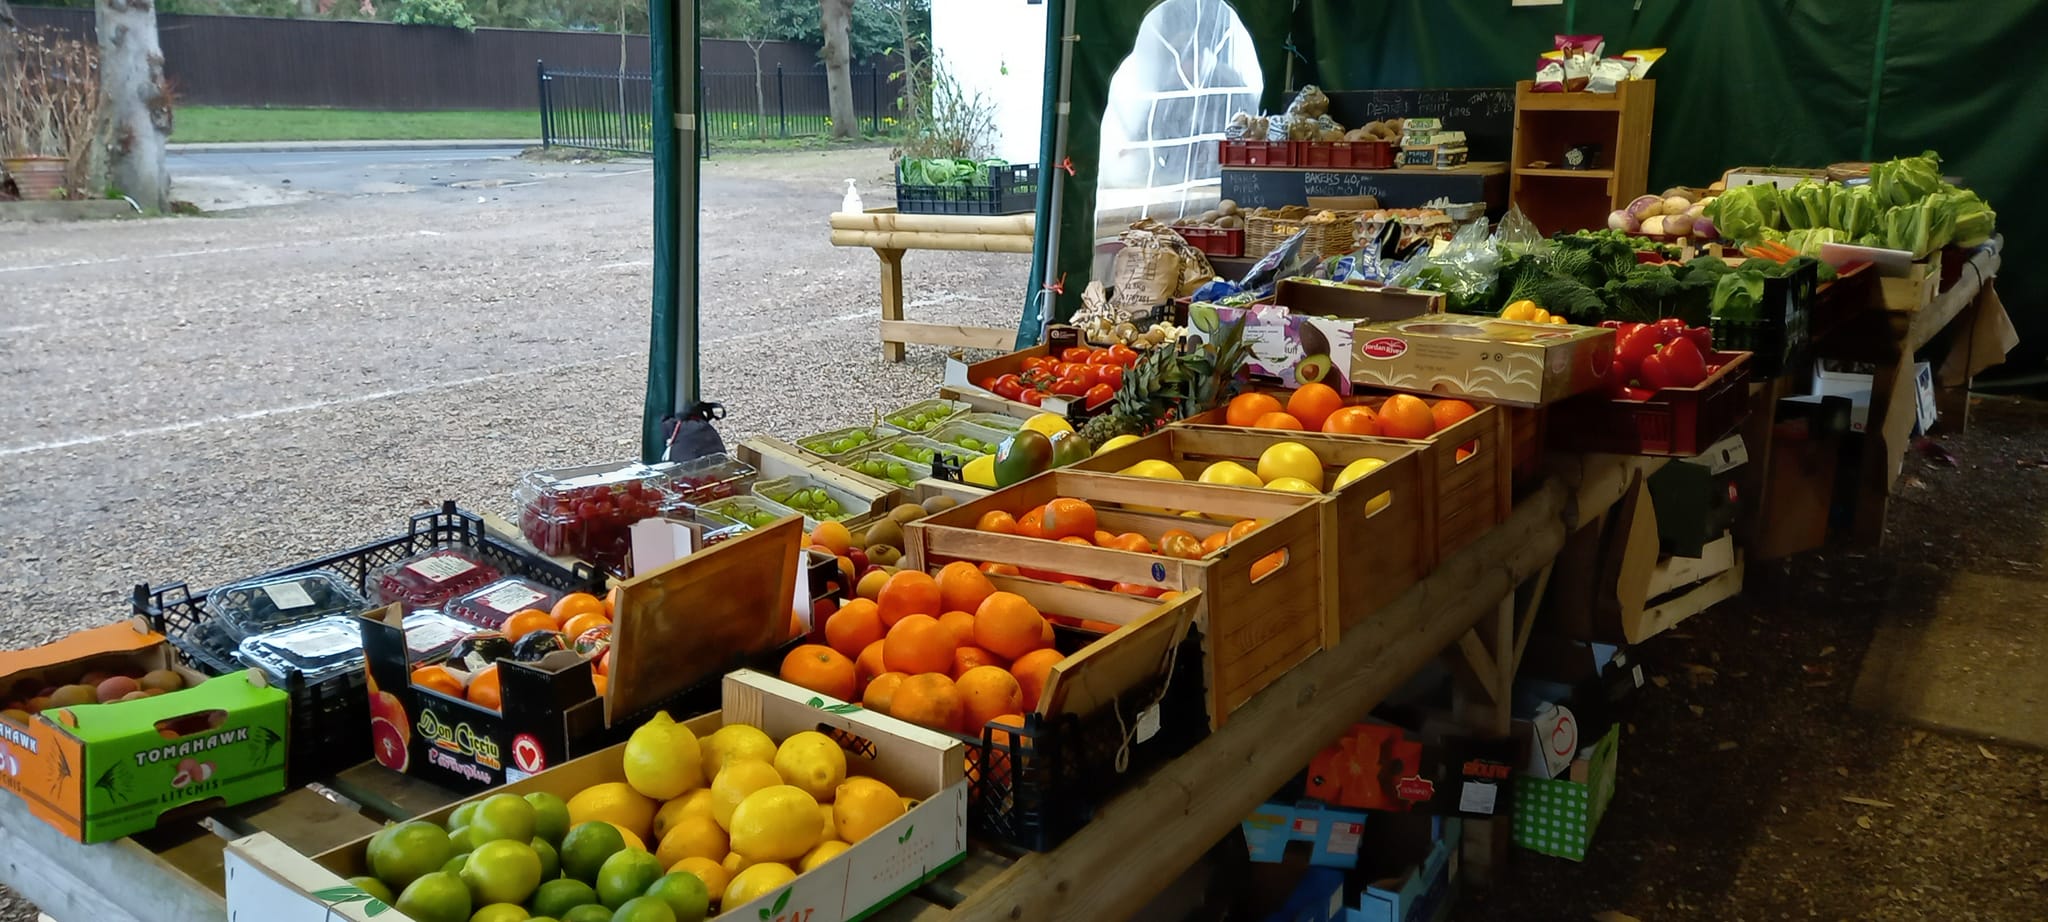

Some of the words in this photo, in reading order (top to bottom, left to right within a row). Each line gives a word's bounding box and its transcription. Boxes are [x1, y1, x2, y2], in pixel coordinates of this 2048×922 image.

[417, 708, 452, 740] Don
[135, 727, 249, 767] TOMAHAWK
[160, 780, 220, 804] LITCHIS
